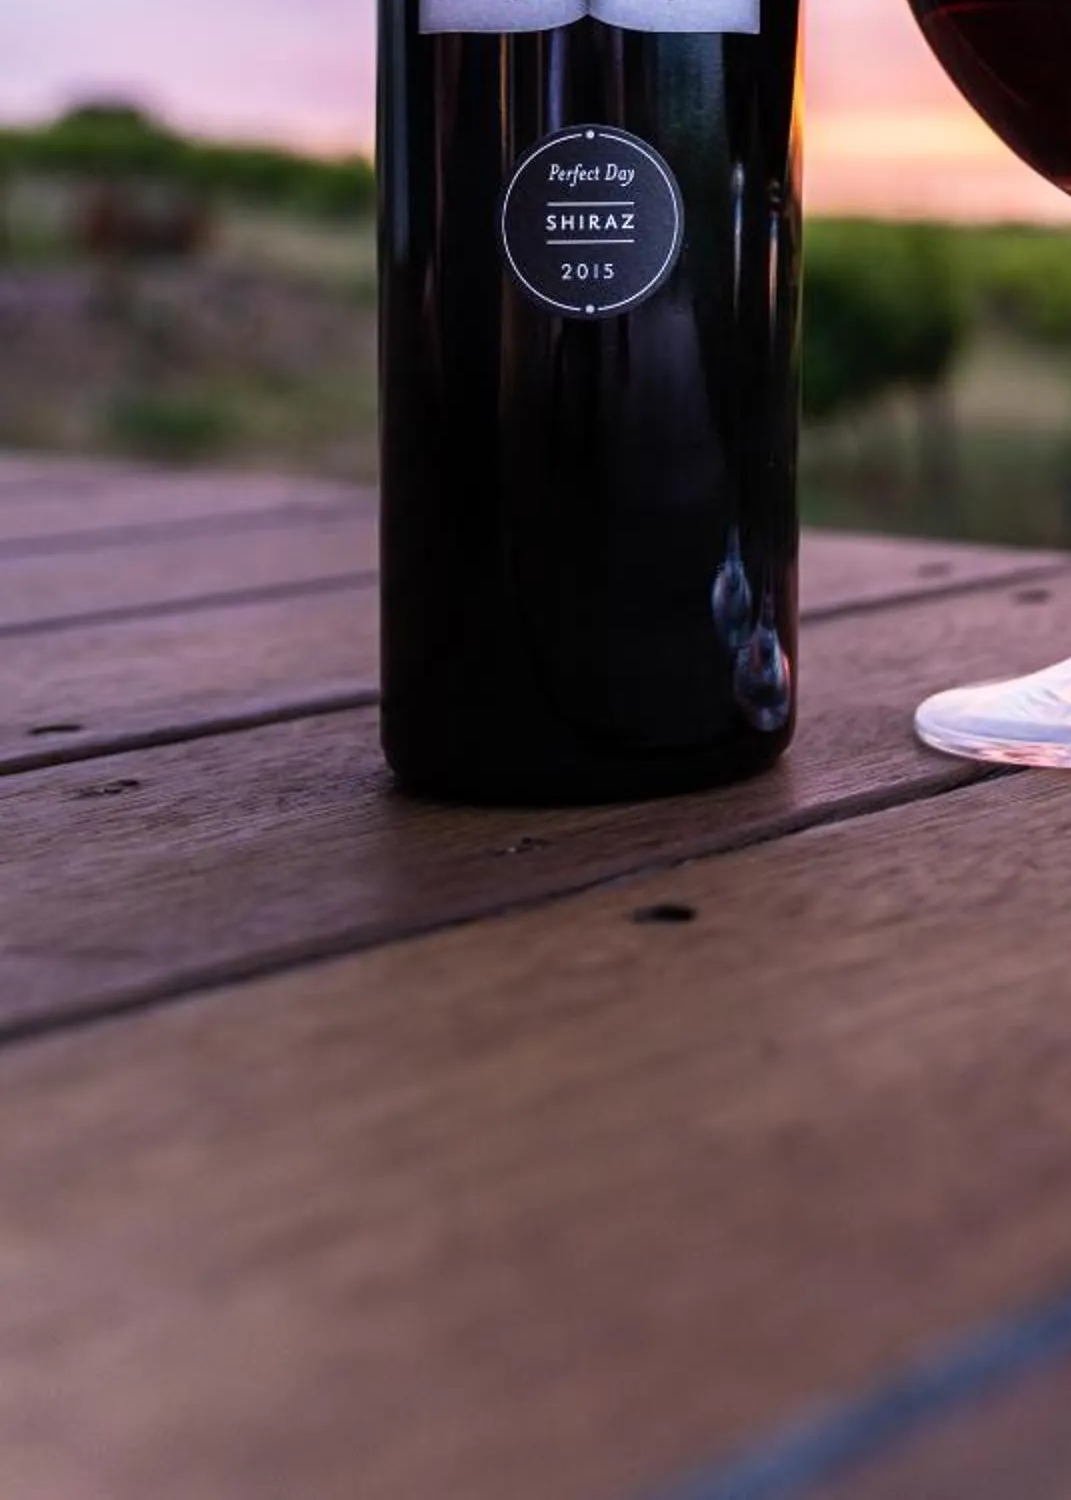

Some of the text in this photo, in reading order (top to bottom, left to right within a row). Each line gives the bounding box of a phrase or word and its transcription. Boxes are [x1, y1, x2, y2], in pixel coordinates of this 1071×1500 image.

[548, 163, 635, 187] Perfect Day
[546, 213, 635, 231] SHIRAZ
[561, 263, 615, 280] 2015
